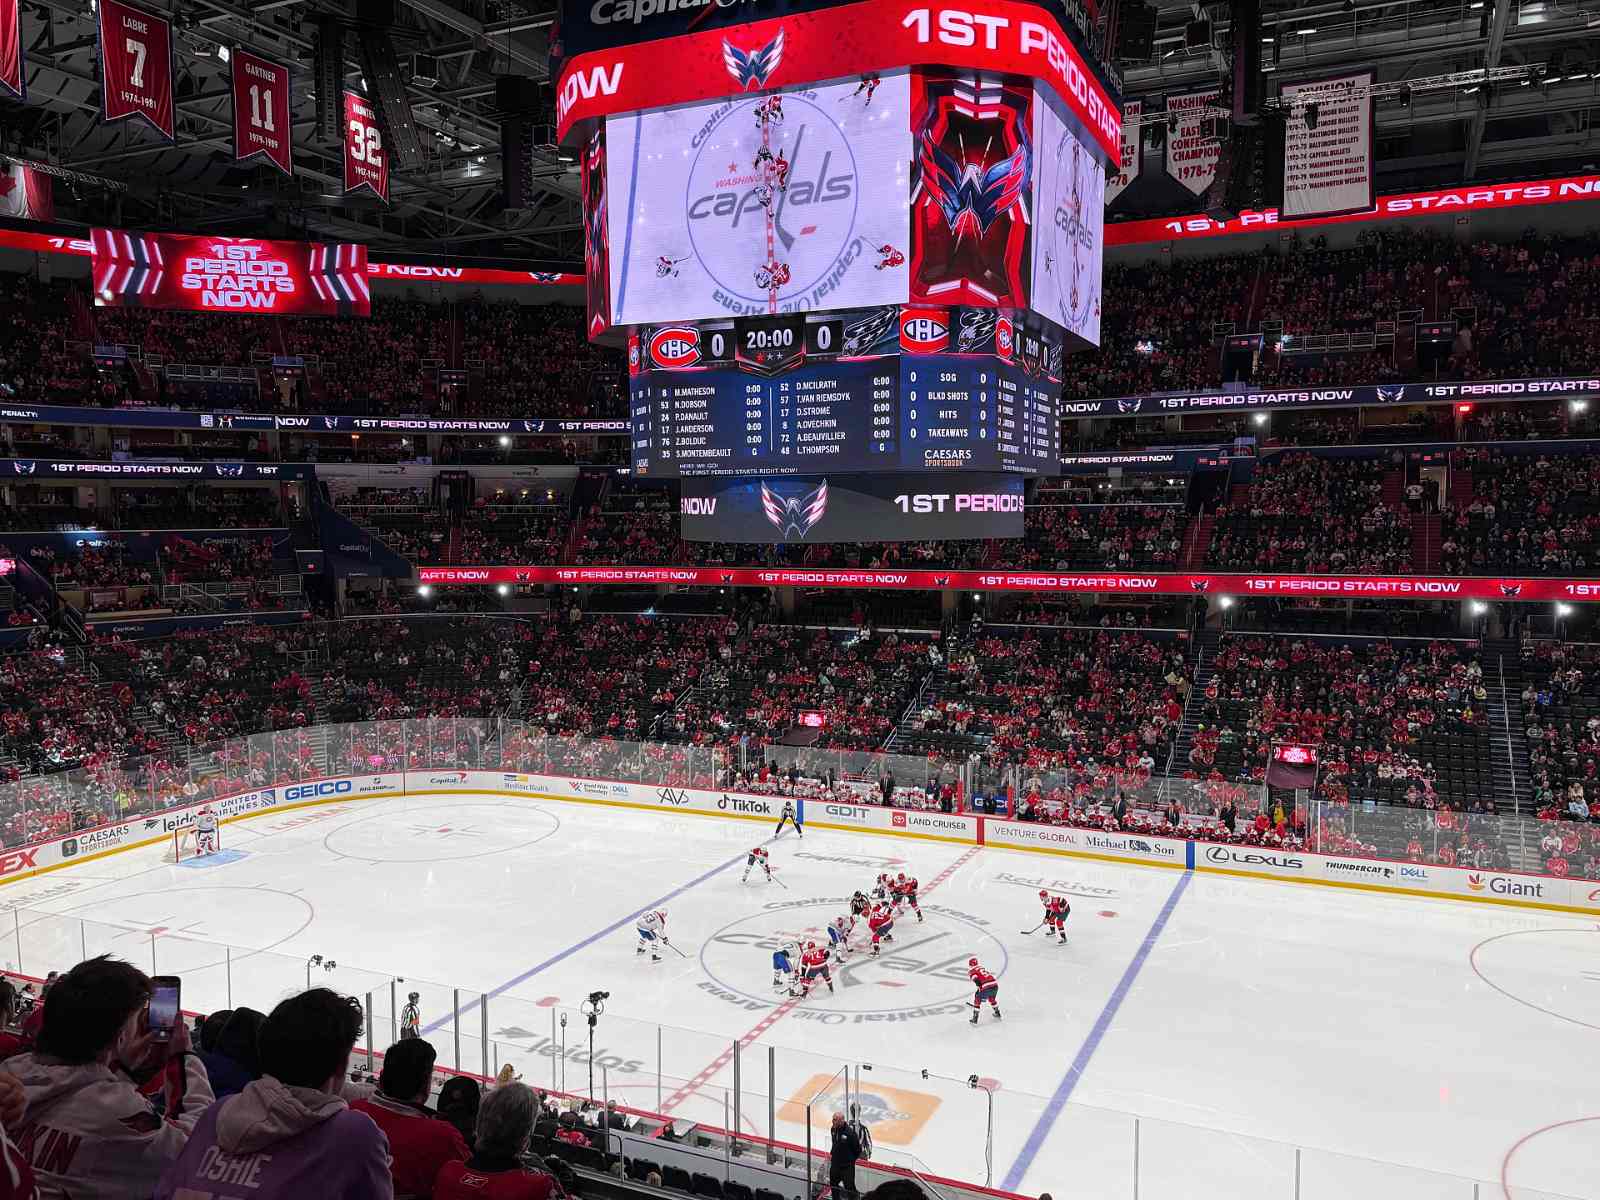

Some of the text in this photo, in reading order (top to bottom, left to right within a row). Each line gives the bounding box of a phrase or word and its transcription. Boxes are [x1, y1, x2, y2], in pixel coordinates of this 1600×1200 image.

[122, 15, 149, 34] LABRE
[126, 37, 147, 88] 7
[902, 9, 1087, 107] 1ST PERIOD
[245, 62, 277, 83] GARTNER
[558, 62, 625, 119] NOW
[249, 84, 275, 132] 11
[350, 119, 383, 168] 32
[1387, 185, 1550, 212] STARTS
[211, 244, 262, 260] 1ST
[186, 258, 288, 276] PERIOD
[387, 264, 463, 278] NOW
[182, 274, 294, 293] STARTS
[201, 290, 276, 308] NOW
[711, 333, 724, 357] 0
[747, 328, 793, 350] 20:00
[817, 325, 831, 350] 0
[780, 383, 789, 391] 52
[873, 377, 890, 386] 0:00
[910, 371, 987, 384] 0 SOG 0
[674, 385, 761, 397] M.MATHESON 0:00
[1425, 380, 1600, 396] 1ST PERIOD STARTS
[660, 401, 669, 409] 53
[746, 398, 761, 406] 0:00
[780, 390, 890, 404] 57 T.VAN RIEMSDYK 0:00
[910, 391, 987, 402] 0 BLKD SHOTS 0
[1160, 390, 1353, 408] 1ST PERIOD STARTS NOW
[781, 403, 890, 417] 17 D.STROME 0:00
[1065, 402, 1101, 412] NOW
[278, 417, 310, 426] NOW
[675, 412, 709, 421] P.DANAULT
[746, 410, 762, 418] 0:00
[796, 416, 890, 429] A.OVECHKIN 0:00
[910, 409, 987, 421] 0 HITS 0
[353, 419, 510, 430] 1ST PERIOD STARTS NOW
[559, 421, 624, 430] 1ST PERIOD
[661, 426, 670, 434] 17
[746, 423, 762, 431] 0:00
[662, 438, 670, 446] 76
[747, 435, 762, 443] 0:00
[781, 429, 890, 442] 72 A.BEAUVILLIER 0:00
[910, 428, 987, 439] 0 TAKEAWAYS 0
[676, 449, 732, 458] S.MONTEMBEAULT
[797, 445, 840, 455] L.THOMPSON
[925, 449, 972, 459] CAESARS
[51, 464, 203, 474] 1ST PERIOD STARTS NOW
[256, 466, 278, 474] 1ST
[683, 497, 717, 515] NOW
[894, 494, 1018, 513] 1ST PERIOD
[457, 571, 489, 580] NOW
[580, 571, 623, 579] PERIOD
[625, 571, 668, 580] STARTS
[670, 572, 697, 580] NOW
[758, 573, 908, 583] 1ST PERIOD STARTS NOW
[979, 576, 1158, 588] 1ST PERIOD STARTS NOW
[1245, 580, 1460, 593] 1ST PERIOD STARTS NOW
[284, 780, 352, 801] GEICO
[221, 794, 258, 808] UNITED
[731, 798, 771, 814] TikTok
[826, 804, 870, 819] GDIT
[908, 816, 966, 831] LAND CRUISER
[80, 824, 129, 845] CAESARS
[994, 826, 1077, 844] VENTURE GLOBAL
[1086, 836, 1175, 856] Michael Son
[1232, 852, 1303, 868] LEXUS
[1326, 861, 1382, 873] THUNDERCAT
[1400, 867, 1429, 878] DELL
[996, 871, 1120, 895] Red River
[1489, 877, 1544, 897] Giant
[695, 981, 770, 1011] Arena
[853, 1003, 965, 1024] Capital
[525, 1037, 645, 1073] leidos
[195, 1144, 273, 1190] OSHIE
